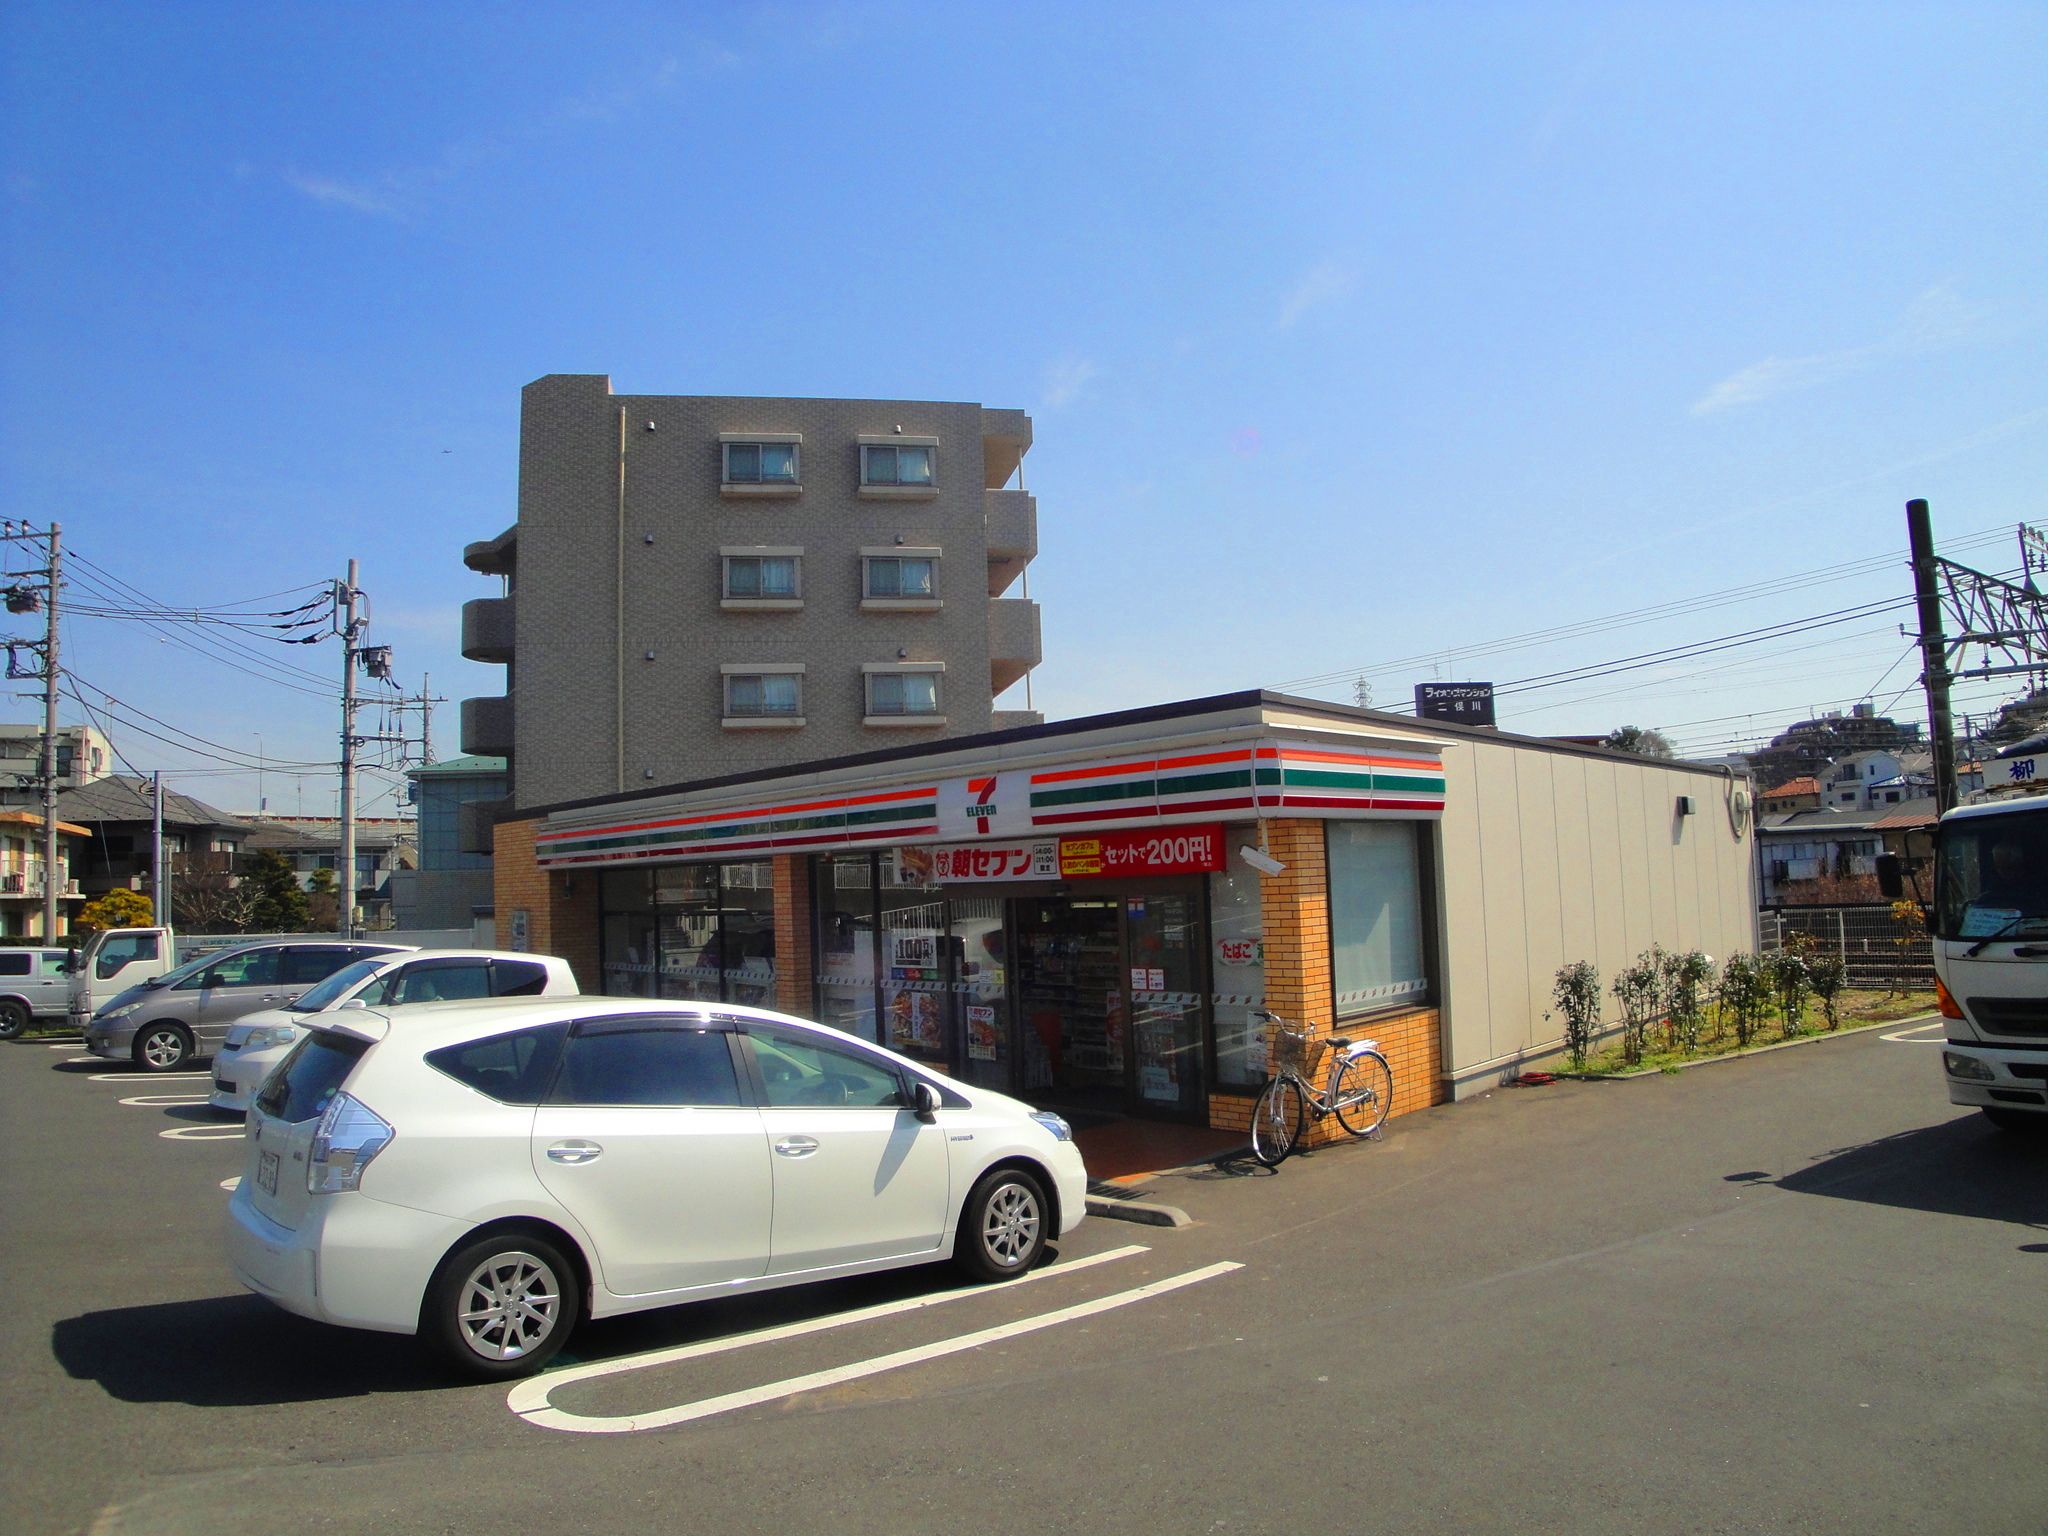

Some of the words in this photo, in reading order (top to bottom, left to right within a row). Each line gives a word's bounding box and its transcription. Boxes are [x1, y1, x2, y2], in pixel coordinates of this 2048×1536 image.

[1425, 687, 1491, 698] ライオンズマンション
[1437, 701, 1481, 711] 二俣川
[2009, 759, 2035, 780] 柳
[967, 776, 997, 834] 7
[951, 848, 1032, 877] 朝セブン
[1222, 943, 1252, 959] たばこ
